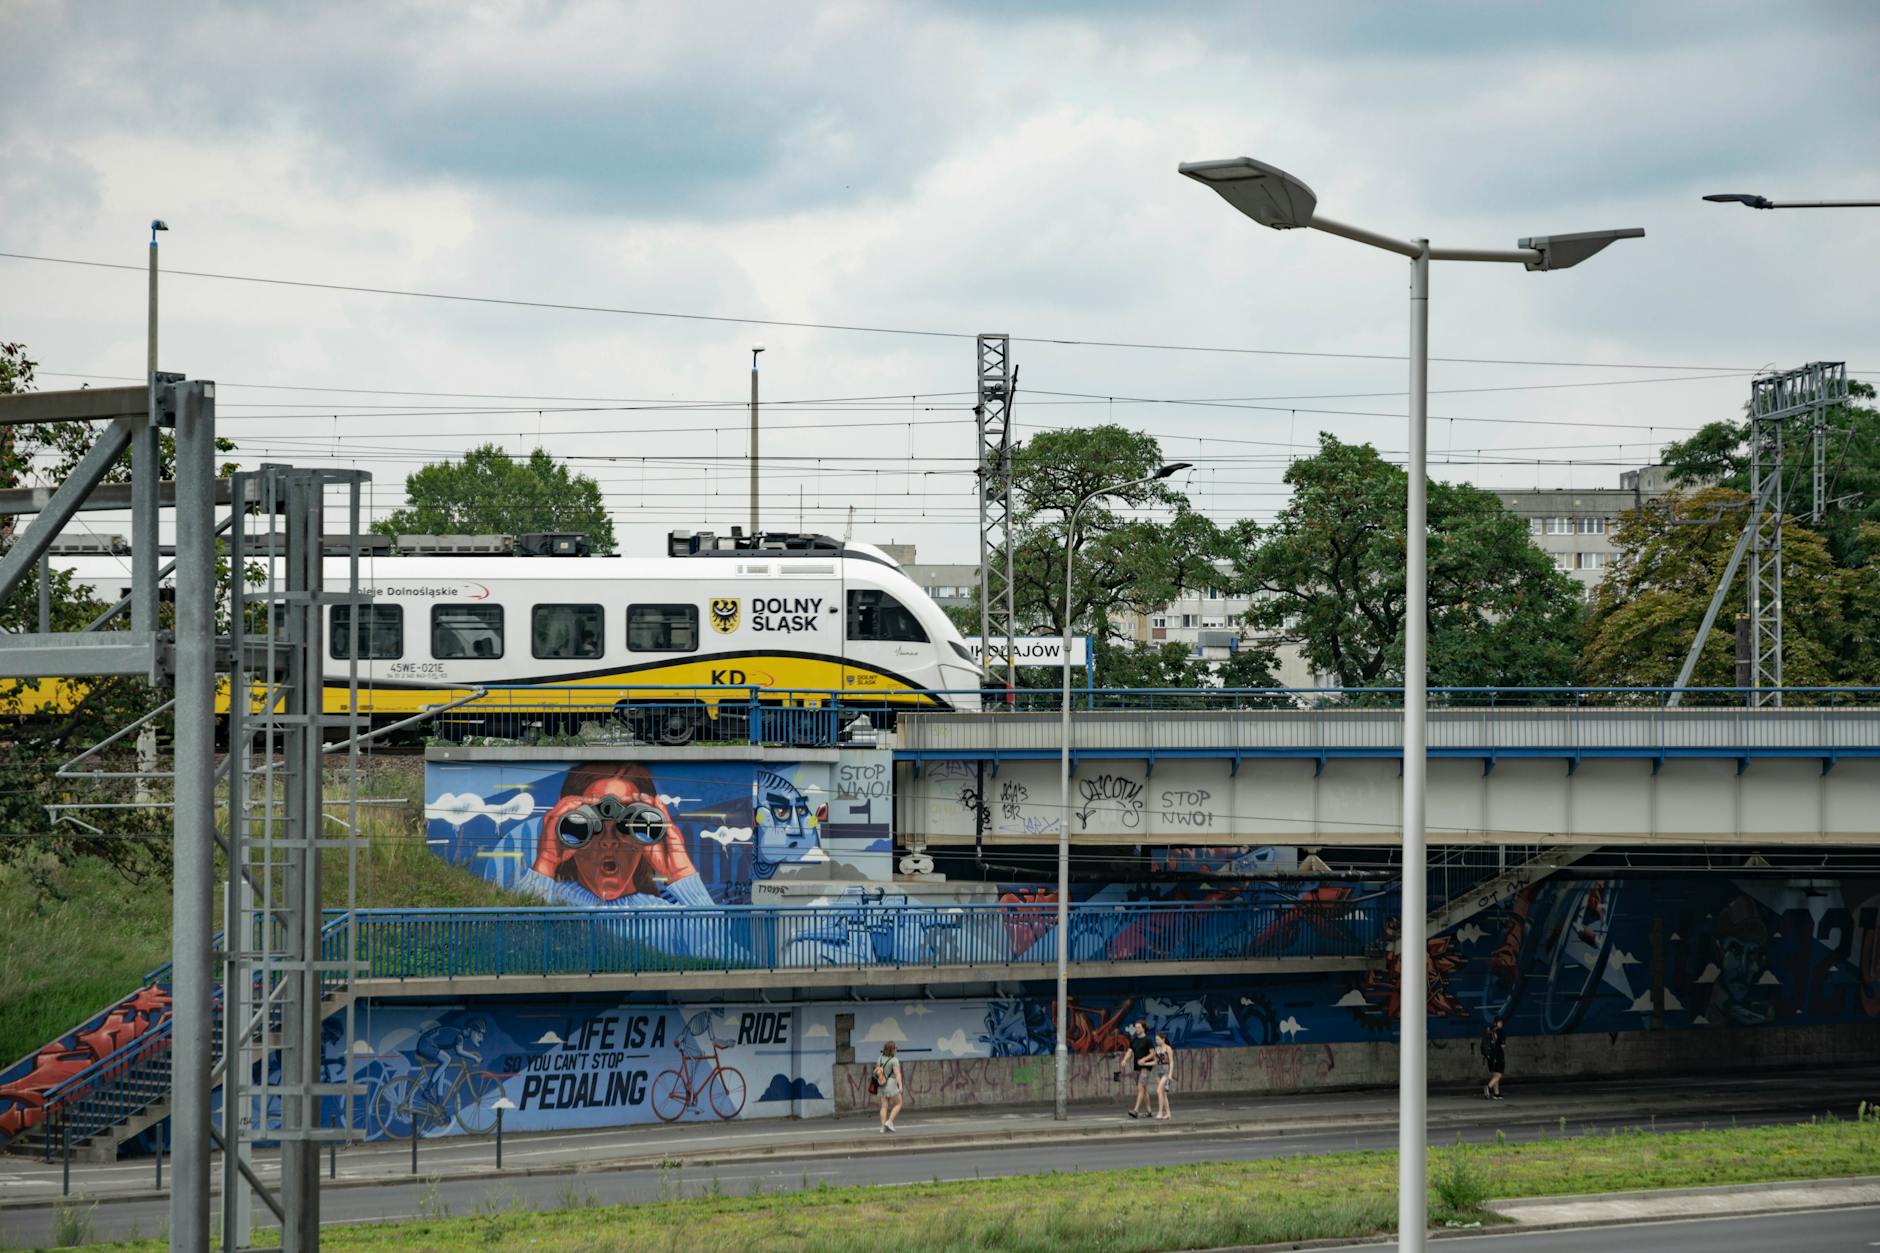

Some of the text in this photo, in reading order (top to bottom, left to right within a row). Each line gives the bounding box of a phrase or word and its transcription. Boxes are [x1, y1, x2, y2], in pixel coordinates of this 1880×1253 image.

[357, 587, 458, 598] oleje Dolnośląskie
[752, 599, 822, 613] DOLNY
[752, 613, 817, 633] ŚLĄSK
[390, 663, 444, 673] 45WE-021E
[712, 670, 746, 685] KD
[841, 764, 885, 780] STOP
[837, 780, 891, 801] NWO!
[1161, 789, 1211, 808] STOP
[1161, 810, 1213, 826] NWO!
[562, 1011, 791, 1051] LIFE IS A RIDE
[504, 1052, 624, 1073] SO YOU CAN'T STOP
[519, 1071, 648, 1110] PEDALING
